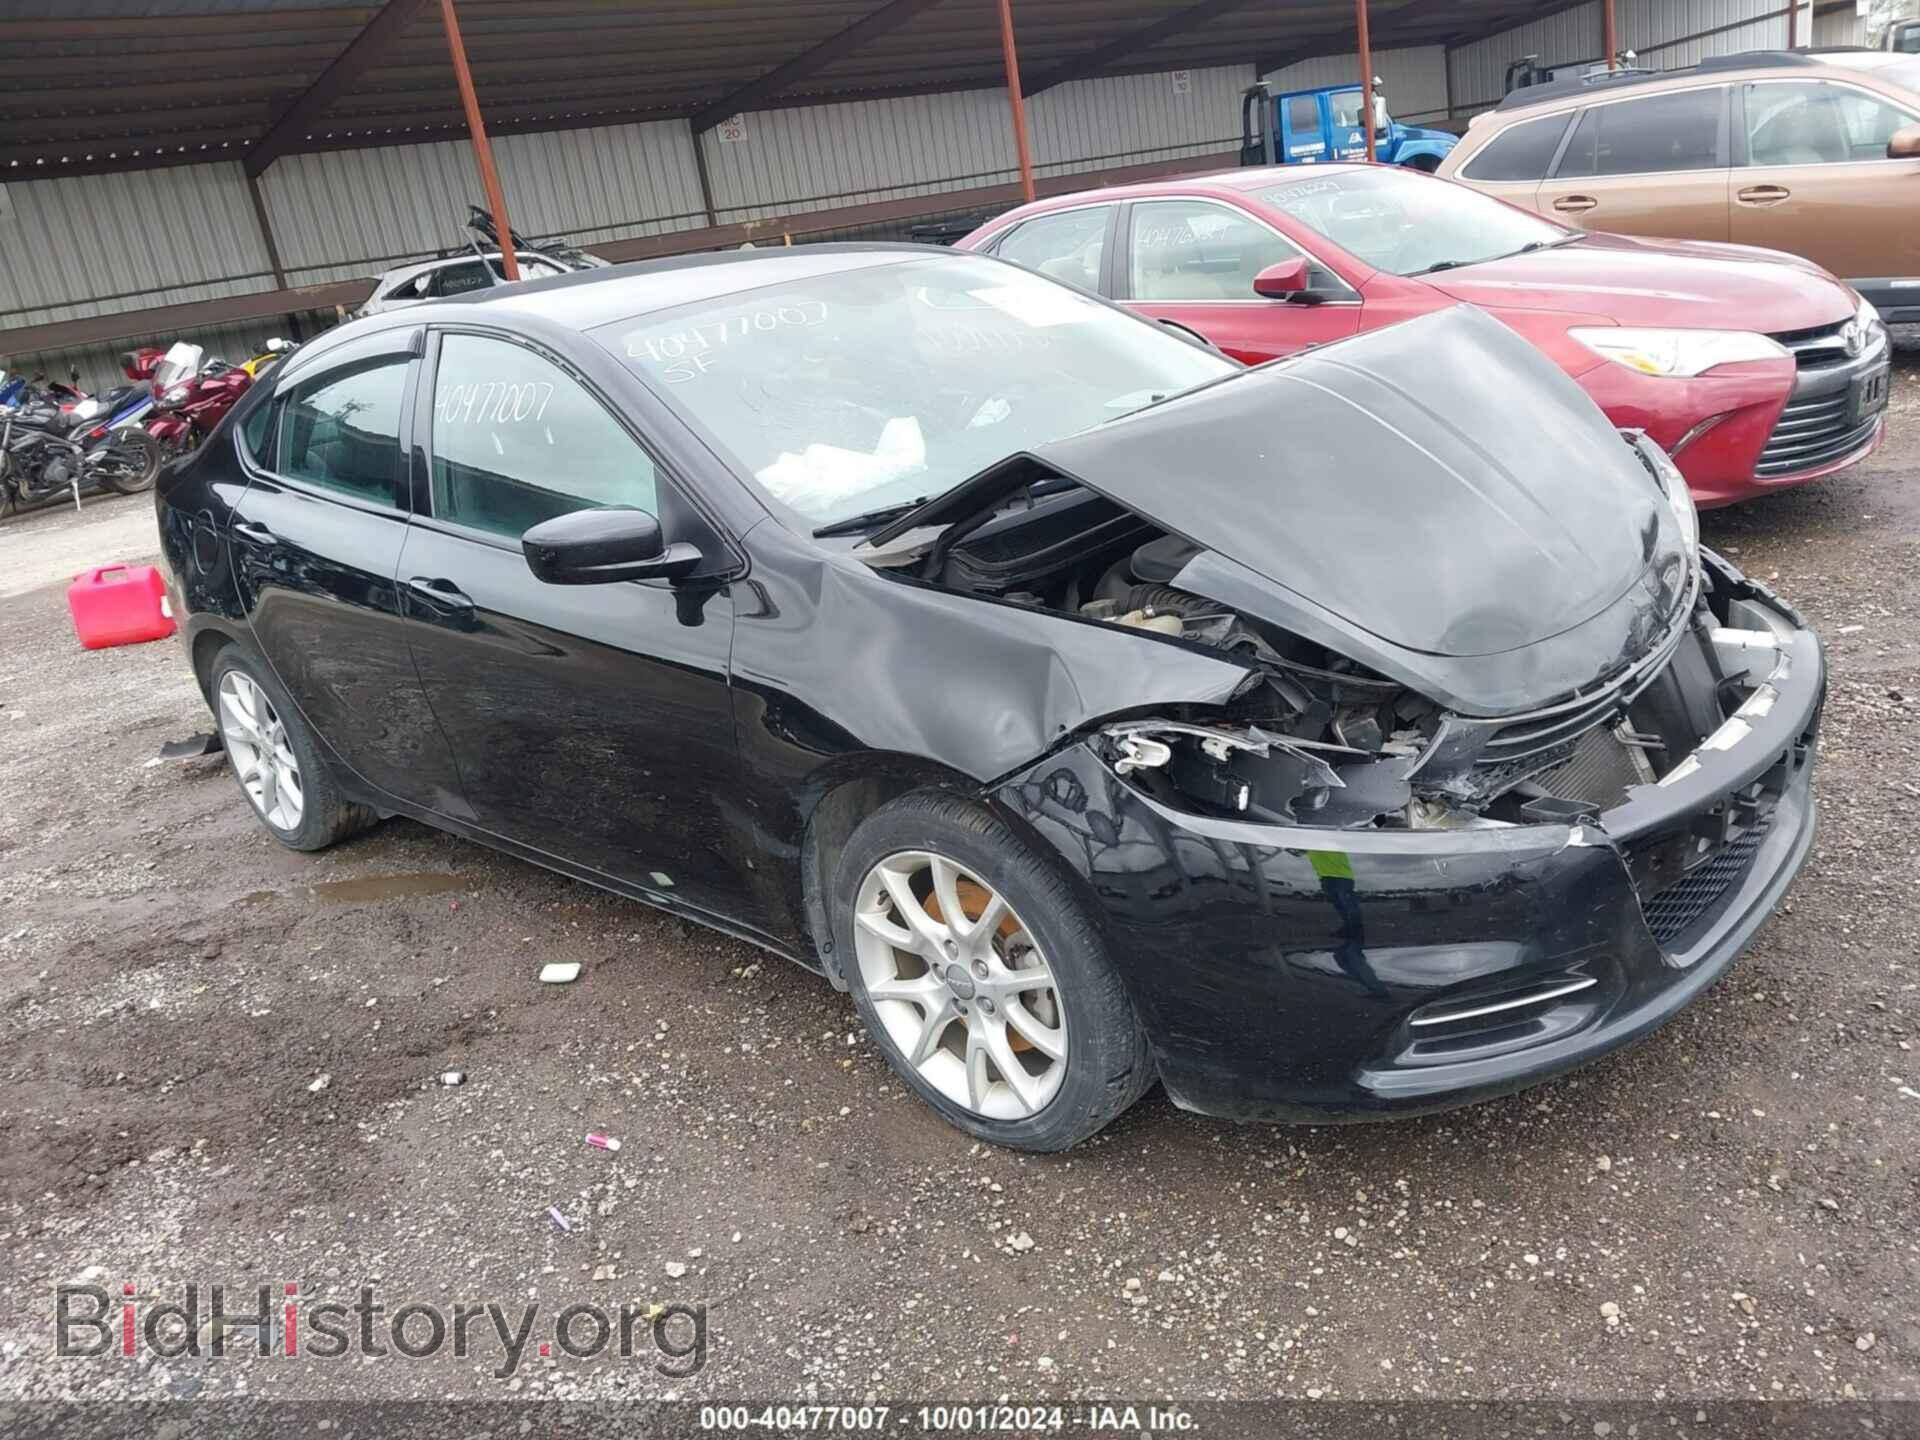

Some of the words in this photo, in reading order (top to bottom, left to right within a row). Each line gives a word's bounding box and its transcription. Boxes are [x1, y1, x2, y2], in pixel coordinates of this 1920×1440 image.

[724, 128, 740, 140] 20
[627, 301, 827, 361] 40477007
[435, 381, 554, 423] 40477007
